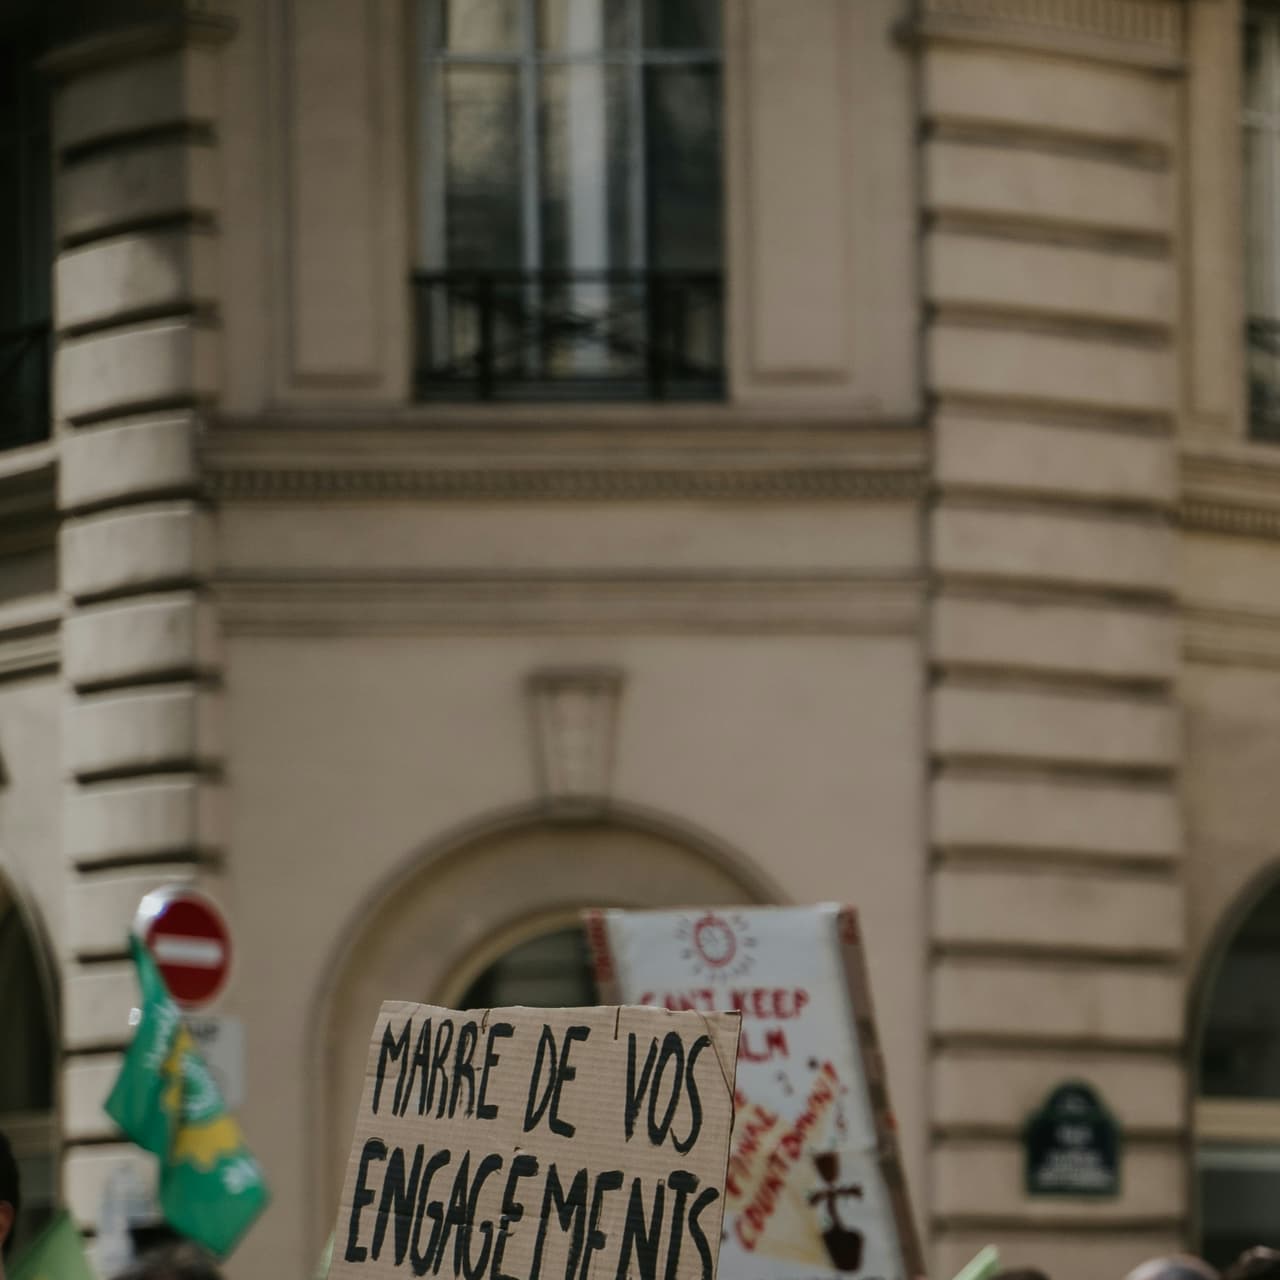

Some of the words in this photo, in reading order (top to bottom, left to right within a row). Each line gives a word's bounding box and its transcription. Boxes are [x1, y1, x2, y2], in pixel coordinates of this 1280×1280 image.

[730, 985, 811, 1020] KEEP
[372, 1018, 513, 1119] MARRE
[524, 1025, 591, 1137] DE
[625, 1031, 711, 1153] VOS
